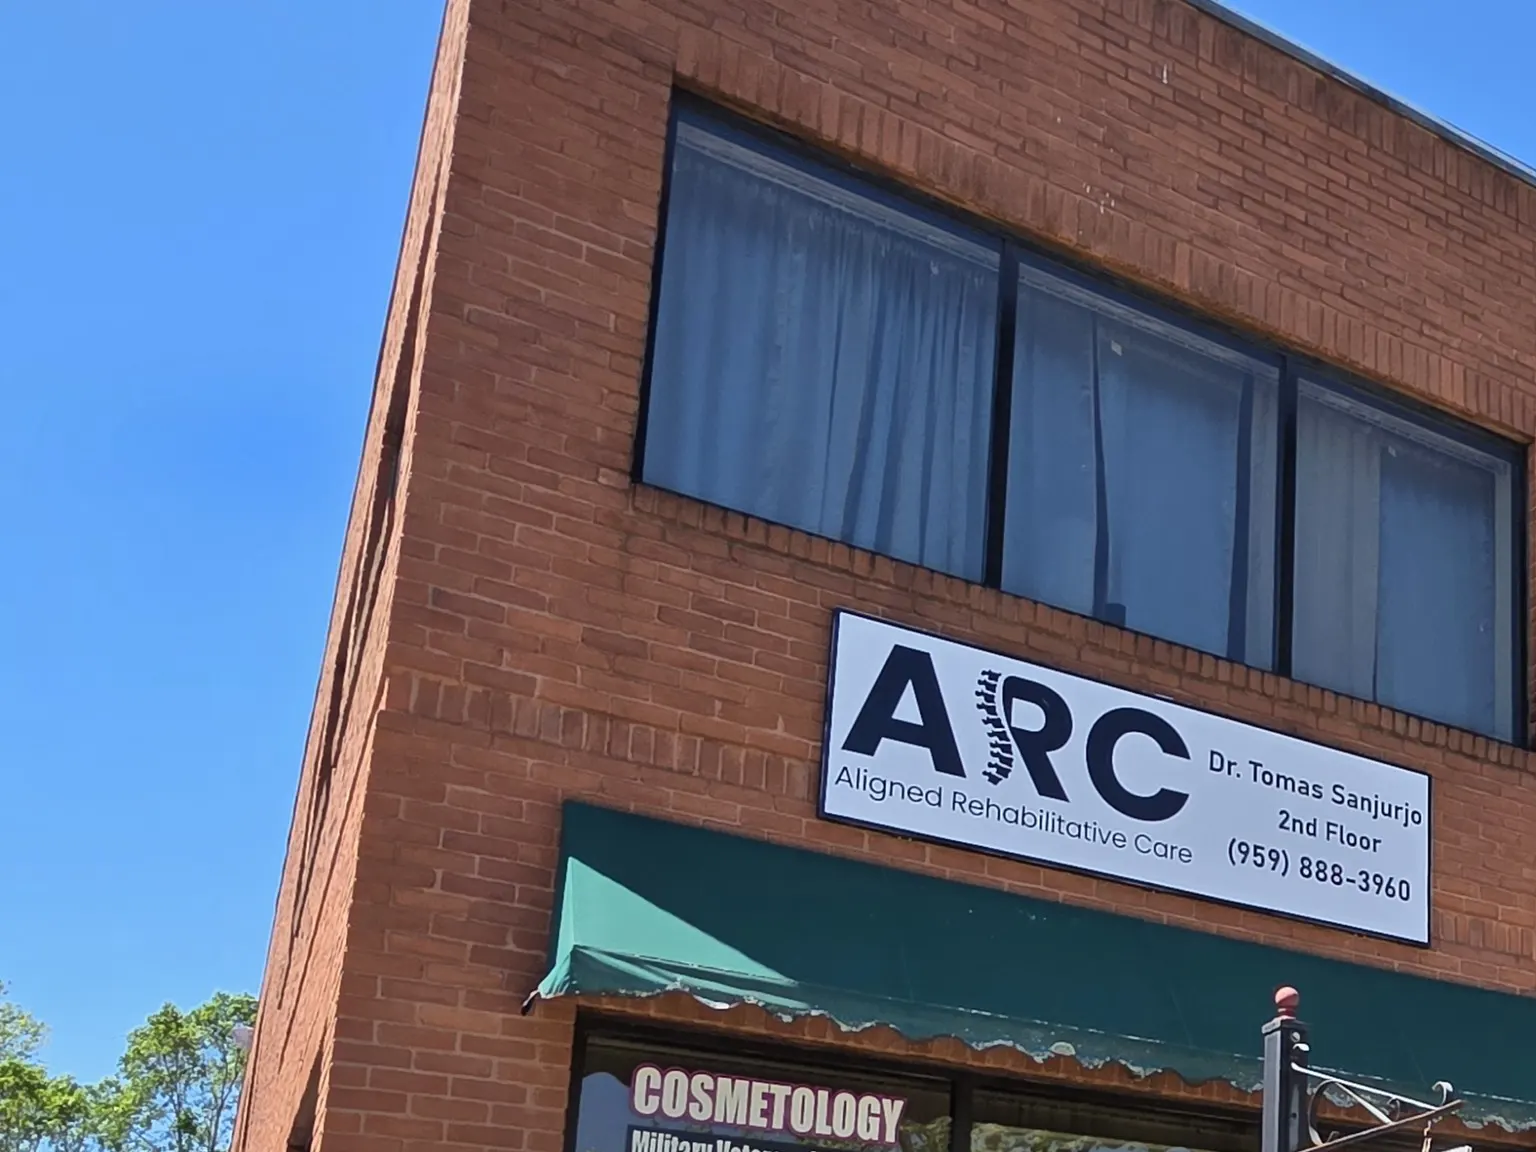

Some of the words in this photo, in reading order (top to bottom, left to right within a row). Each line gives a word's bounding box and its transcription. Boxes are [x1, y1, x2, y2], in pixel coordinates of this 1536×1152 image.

[841, 644, 1191, 821] ARC
[834, 765, 943, 809] Aligned
[952, 791, 1128, 849] Rehabilitative
[1134, 833, 1193, 865] Care
[1208, 750, 1242, 778] Dr.
[1249, 761, 1325, 800] Tomas
[1330, 783, 1423, 827] Sanjurjo
[1277, 809, 1319, 840] 2nd
[1325, 821, 1382, 854] Floor
[1227, 838, 1290, 878] (959)
[1298, 855, 1412, 903] 888-3960
[633, 1066, 904, 1144] COSMETOLOGY
